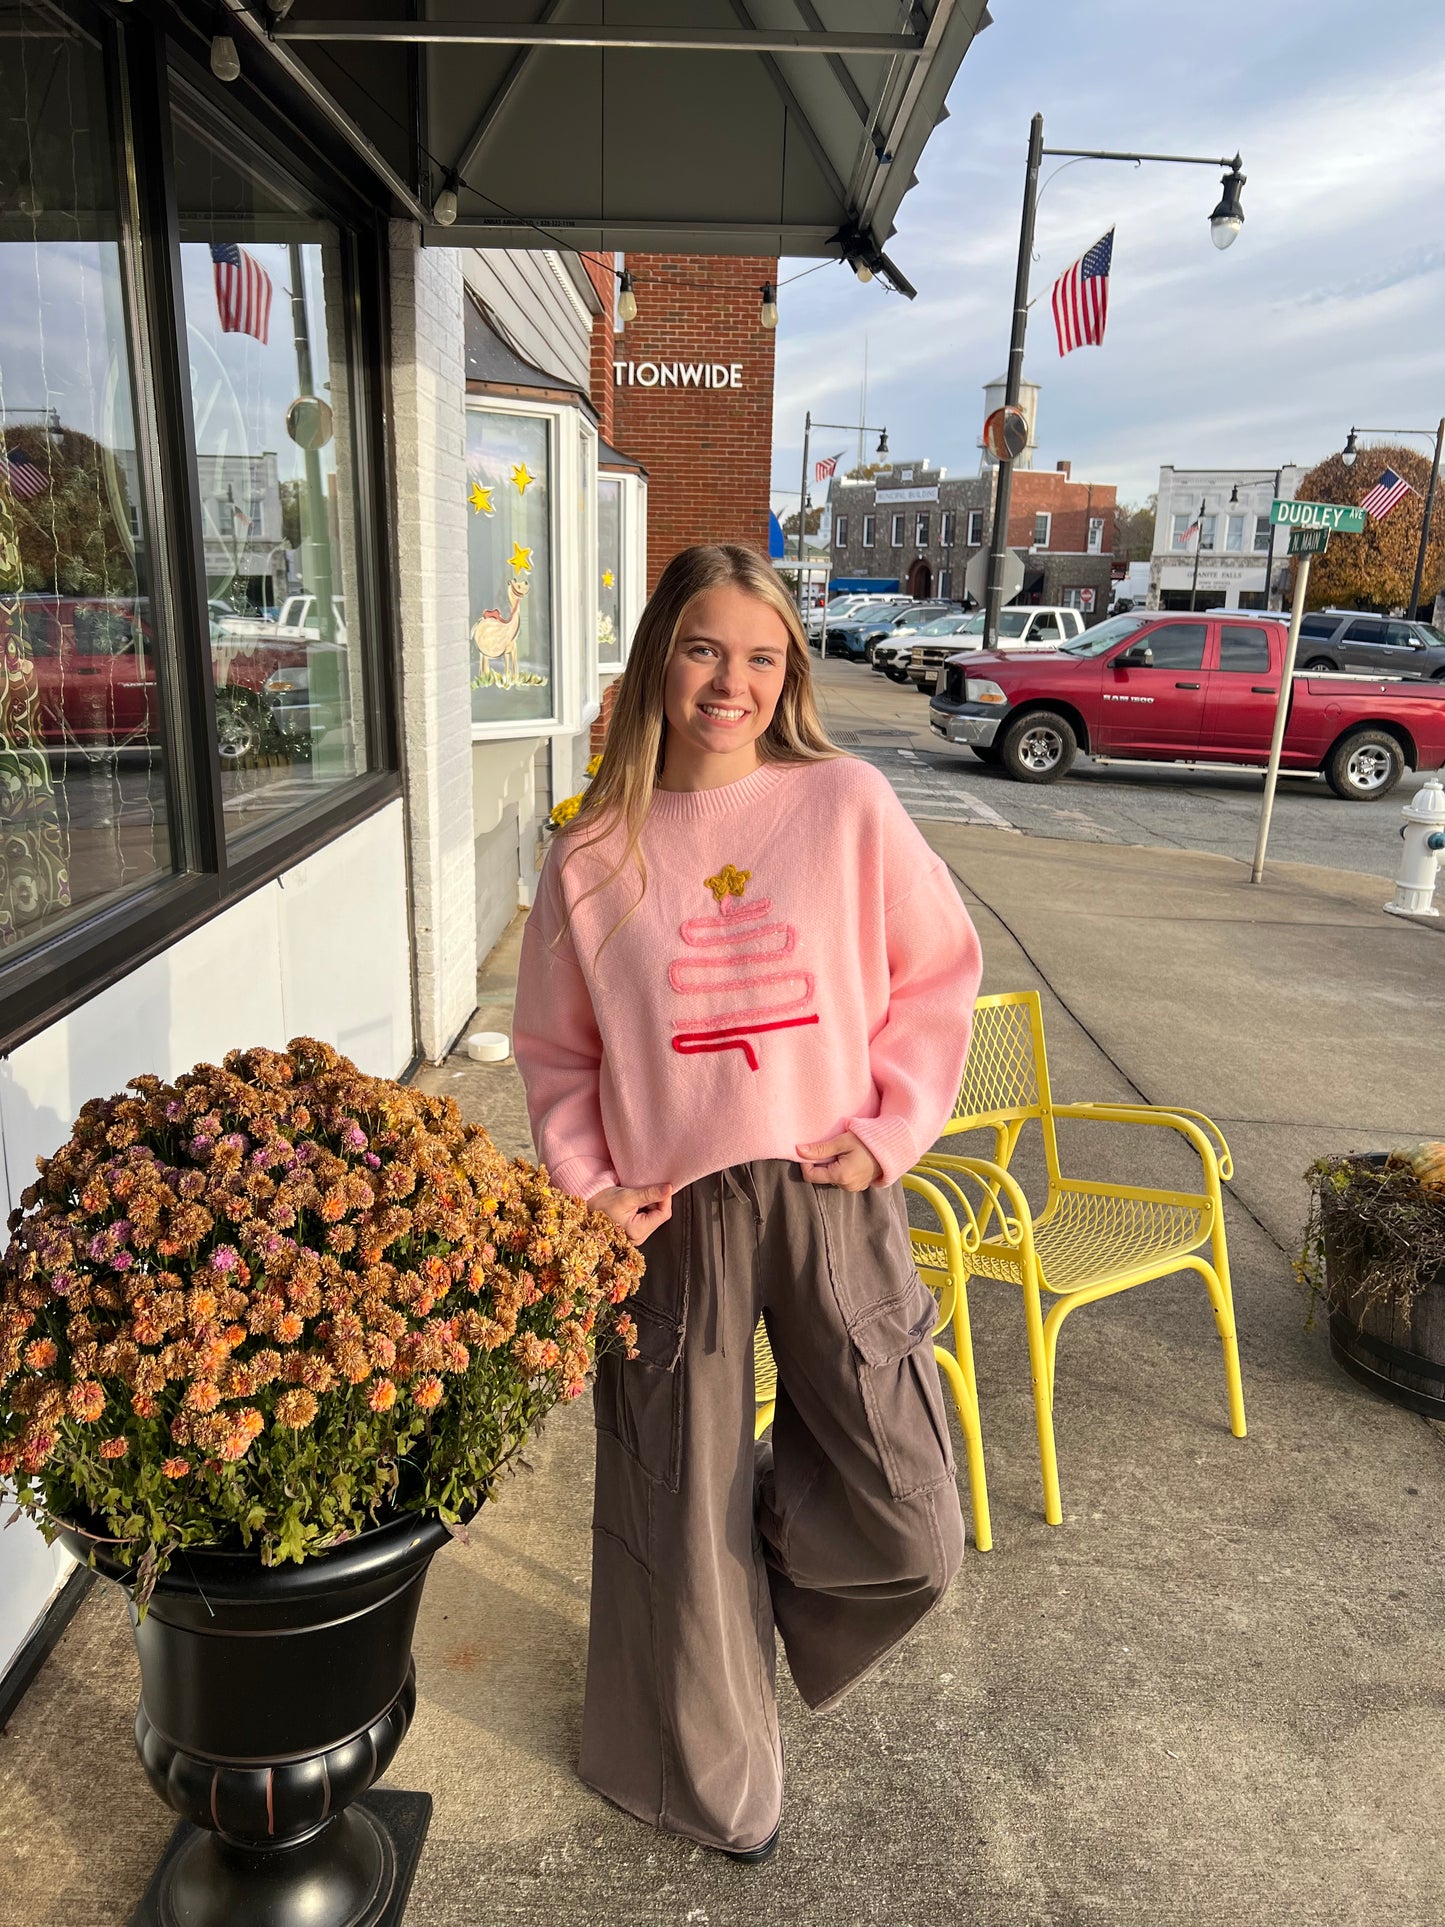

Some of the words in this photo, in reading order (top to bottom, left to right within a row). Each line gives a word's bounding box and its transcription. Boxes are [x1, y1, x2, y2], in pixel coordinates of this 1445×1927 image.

[613, 361, 743, 388] TIONWIDE
[1277, 503, 1344, 528] DUDLEY
[1349, 508, 1364, 520] AVE
[1291, 533, 1299, 552] N.
[1300, 531, 1321, 551] MAIN
[1187, 571, 1218, 579] GANITE
[1221, 571, 1242, 579] FALLS
[1103, 694, 1129, 703] RAM
[1130, 696, 1155, 704] 1500
